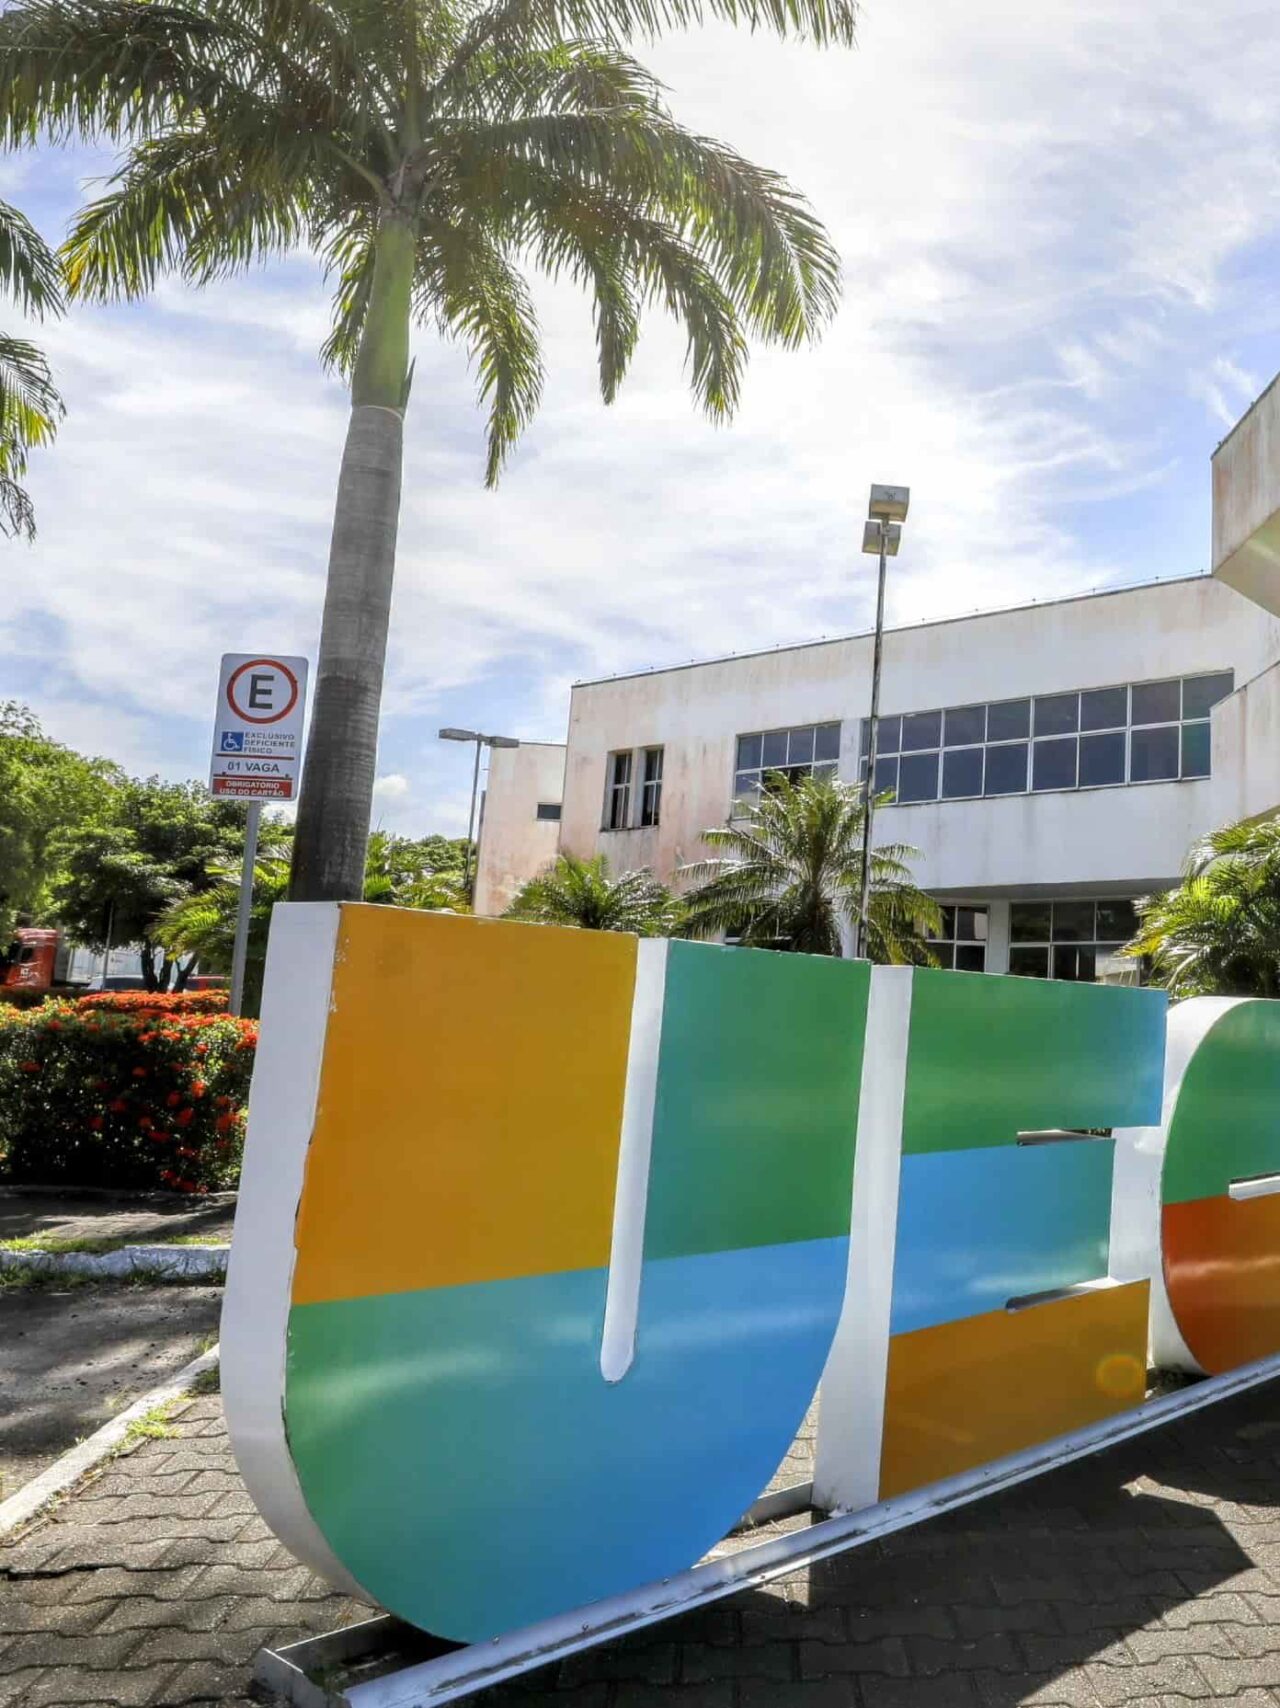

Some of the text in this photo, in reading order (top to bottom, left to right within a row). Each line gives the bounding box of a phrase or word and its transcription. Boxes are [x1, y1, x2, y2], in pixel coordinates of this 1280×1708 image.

[248, 674, 275, 710] E
[245, 732, 295, 740] EXCLUSIVO
[244, 740, 295, 748] DEFICIENTE
[227, 761, 280, 773] 01 VAGA
